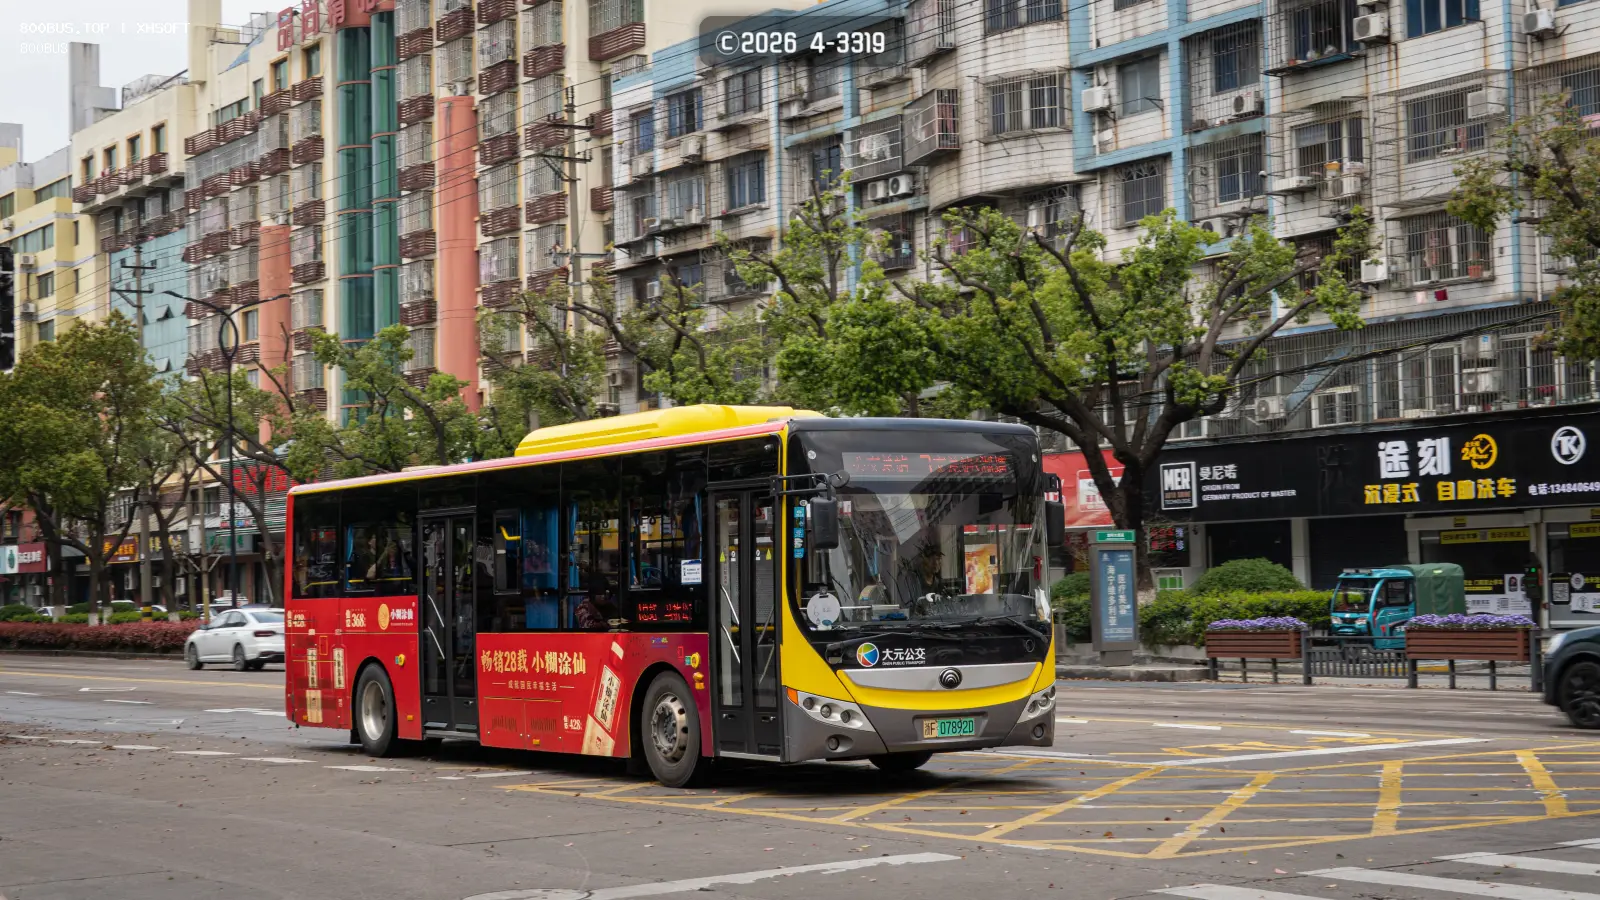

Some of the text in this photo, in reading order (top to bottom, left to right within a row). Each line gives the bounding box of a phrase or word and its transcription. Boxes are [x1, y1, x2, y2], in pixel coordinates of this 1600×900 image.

[1377, 437, 1451, 479] 途刻
[1163, 467, 1191, 492] MER
[1199, 463, 1239, 481] 曼尼诺
[1231, 491, 1260, 500] PRODUCT
[1260, 490, 1270, 499] OF
[1364, 477, 1517, 505] 沉浸式 自助洗车
[480, 648, 587, 676] 畅销28载 小糊涂仙
[881, 647, 926, 661] 大元公交
[940, 719, 974, 735] 07892D
